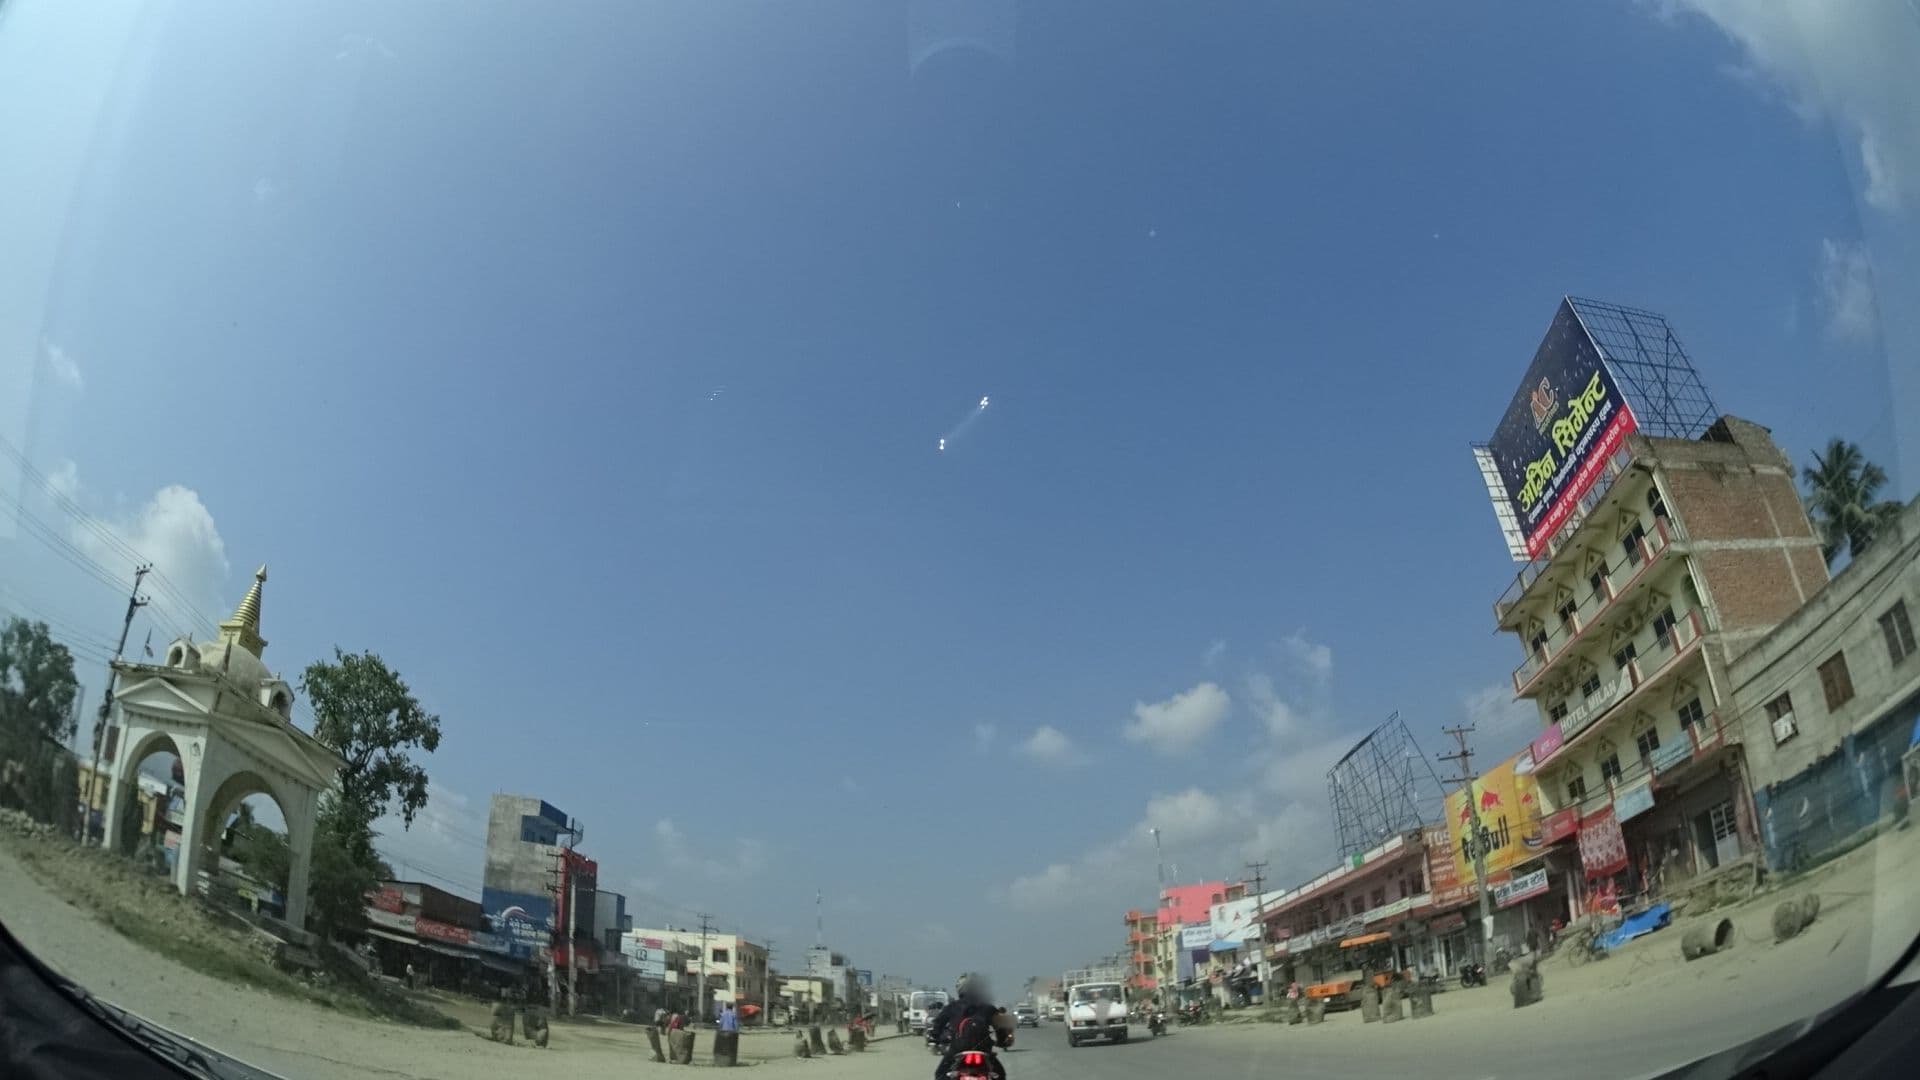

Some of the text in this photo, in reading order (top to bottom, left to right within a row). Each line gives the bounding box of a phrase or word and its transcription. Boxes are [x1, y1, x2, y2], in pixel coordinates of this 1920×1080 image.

[1561, 681, 1616, 731] HOTEL MILAN
[1480, 814, 1509, 854] Bull
